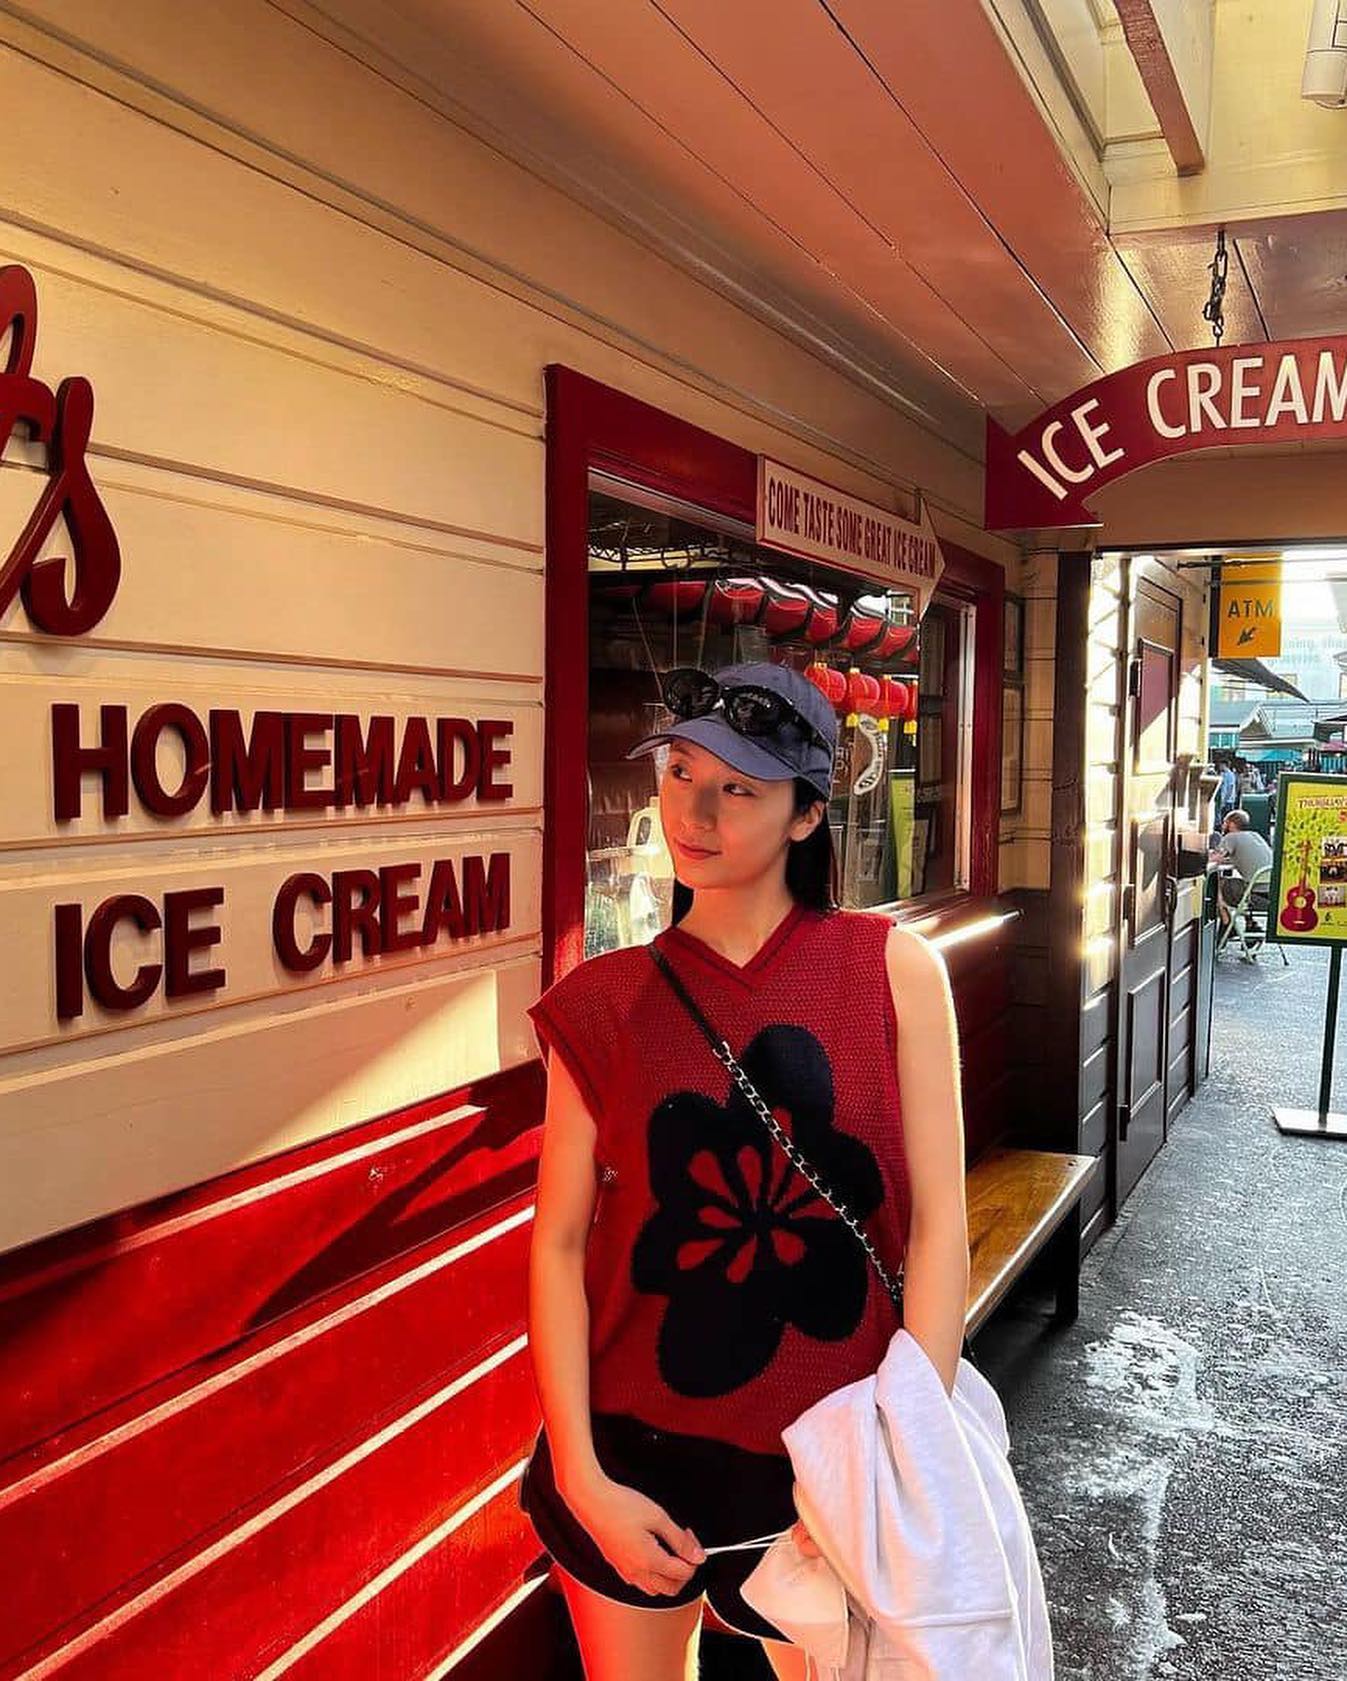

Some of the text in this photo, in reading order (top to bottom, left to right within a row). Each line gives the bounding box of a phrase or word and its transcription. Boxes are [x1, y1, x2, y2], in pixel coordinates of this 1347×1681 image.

[1017, 351, 1347, 500] ICE CREAM
[768, 477, 936, 578] COME TASTE SOME GREAT ICE CREAM
[1227, 598, 1274, 618] ATM
[51, 703, 514, 822] HOMEMADE
[54, 853, 511, 1019] ICE CREAM
